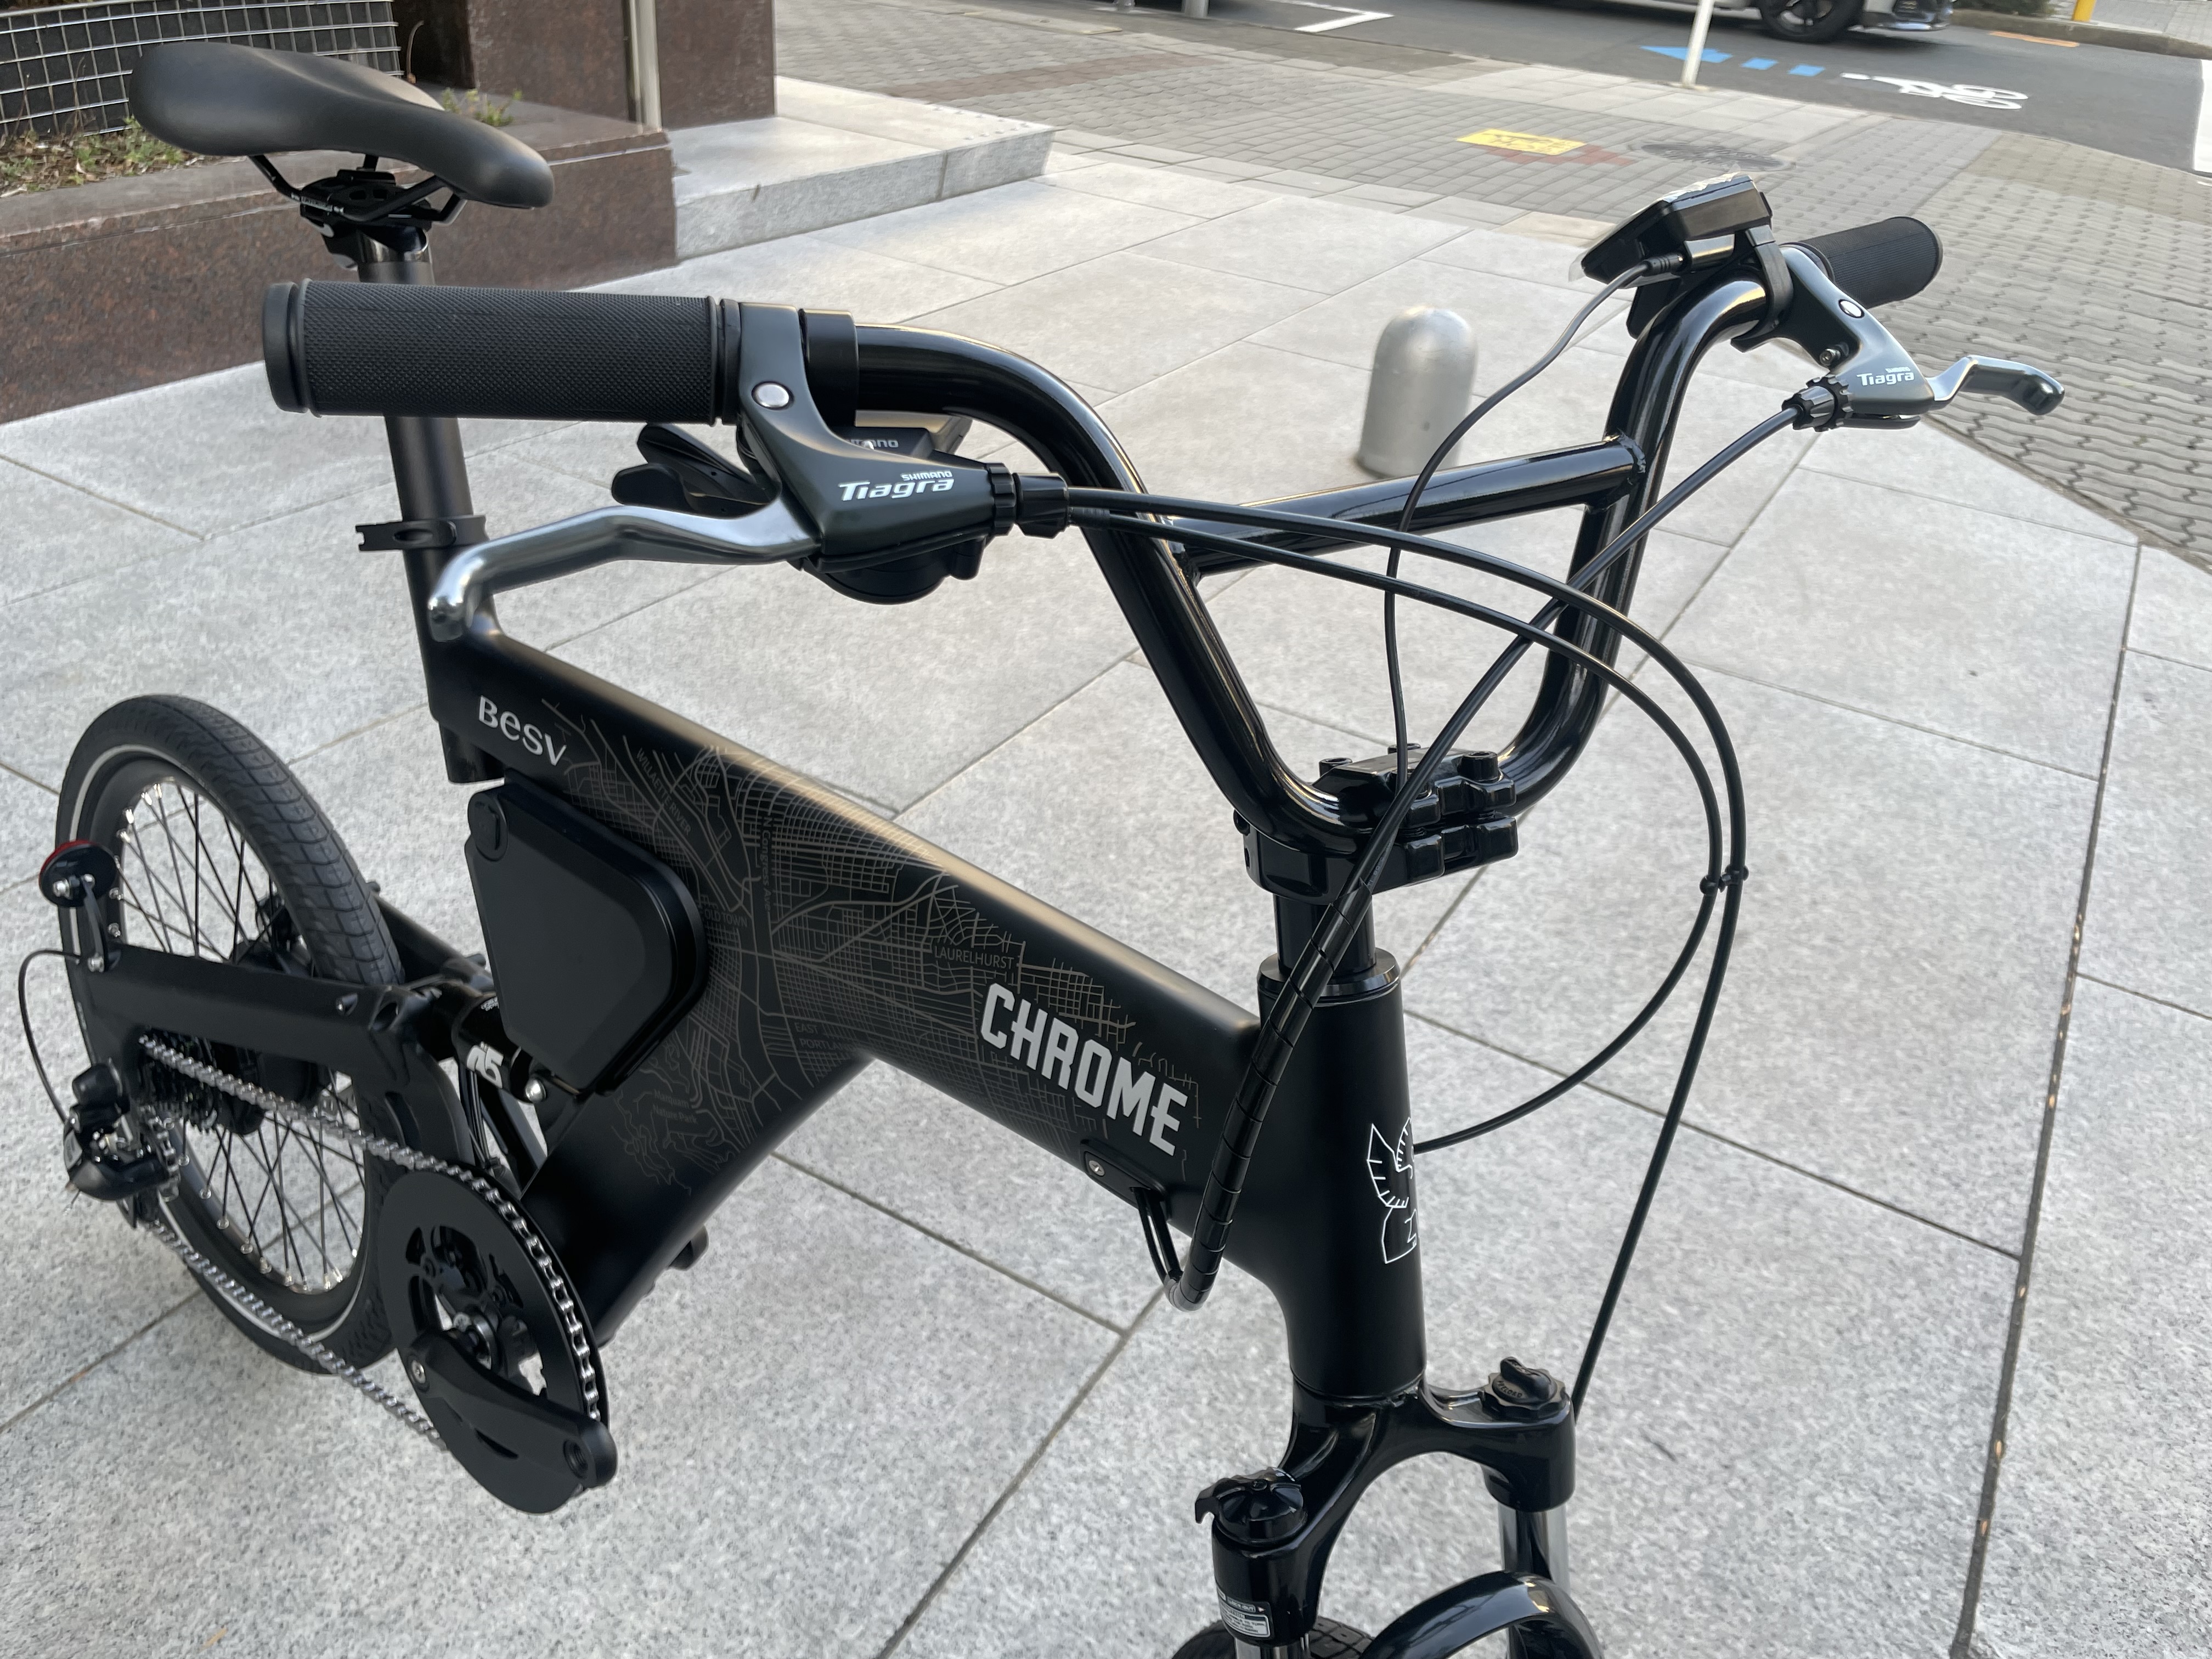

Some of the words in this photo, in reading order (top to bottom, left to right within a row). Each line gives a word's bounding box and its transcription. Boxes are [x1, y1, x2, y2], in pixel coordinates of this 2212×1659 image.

[1857, 373, 1914, 386] Tiagra
[901, 470, 953, 482] SHIMANO
[839, 477, 955, 502] Tiagra
[669, 801, 691, 836] RIVER
[759, 830, 771, 887] Congress
[763, 887, 772, 911] Ave
[704, 909, 721, 922] OLD
[720, 911, 748, 928] TOWN
[934, 945, 1015, 970] LAURELHURST
[794, 1022, 819, 1035] EAST
[981, 983, 1188, 1156] CHROME
[652, 1103, 679, 1121] Nature
[678, 1111, 699, 1125] Park
